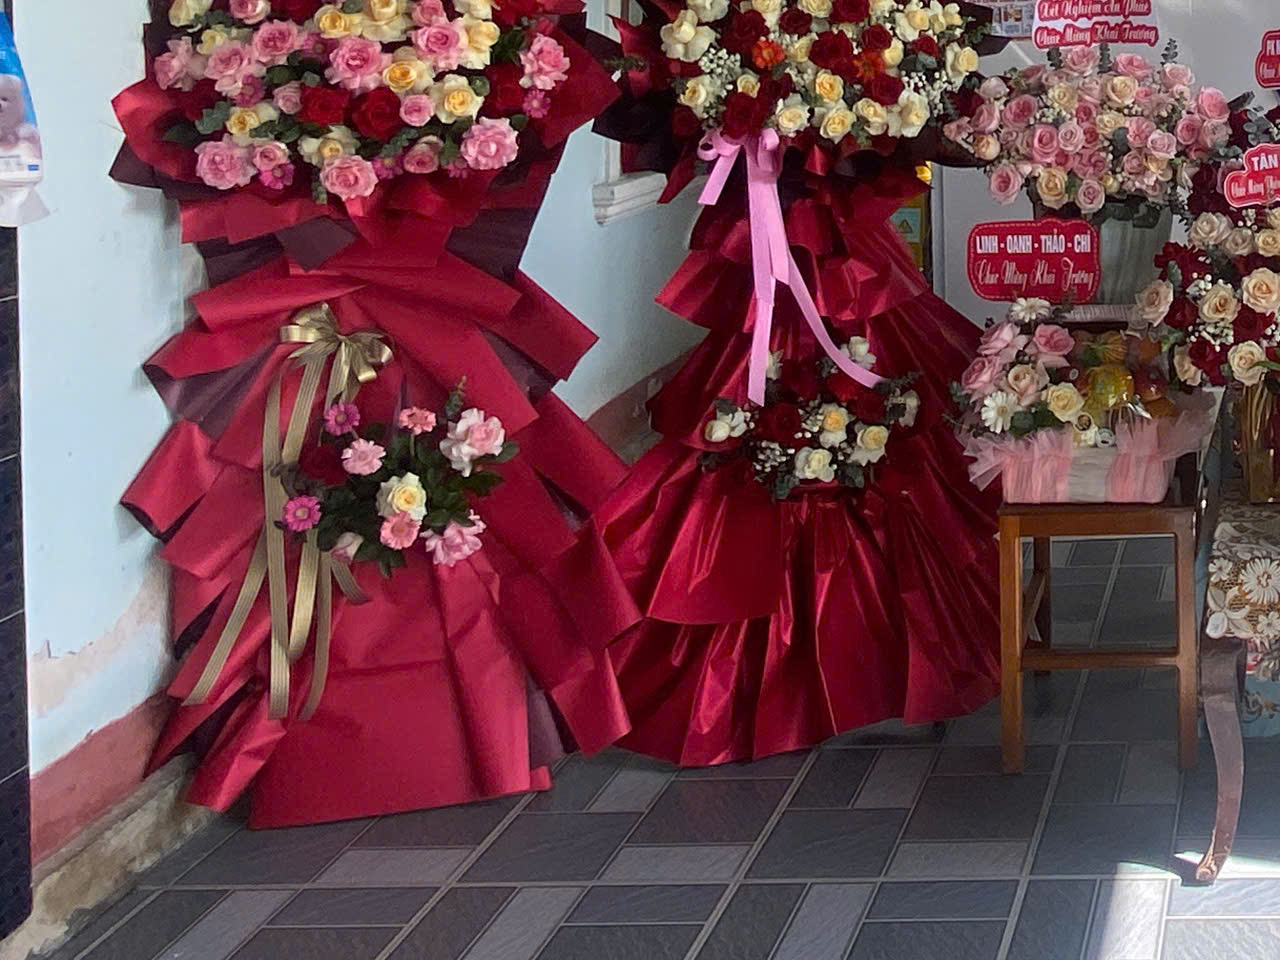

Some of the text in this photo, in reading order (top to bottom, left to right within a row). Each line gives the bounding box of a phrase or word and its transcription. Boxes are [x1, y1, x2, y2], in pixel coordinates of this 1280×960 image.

[1251, 153, 1279, 171] TÂN
[976, 235, 998, 254] LINH
[1006, 234, 1032, 254] OANH
[1040, 228, 1065, 254] THẢO
[975, 259, 999, 285] Chúc
